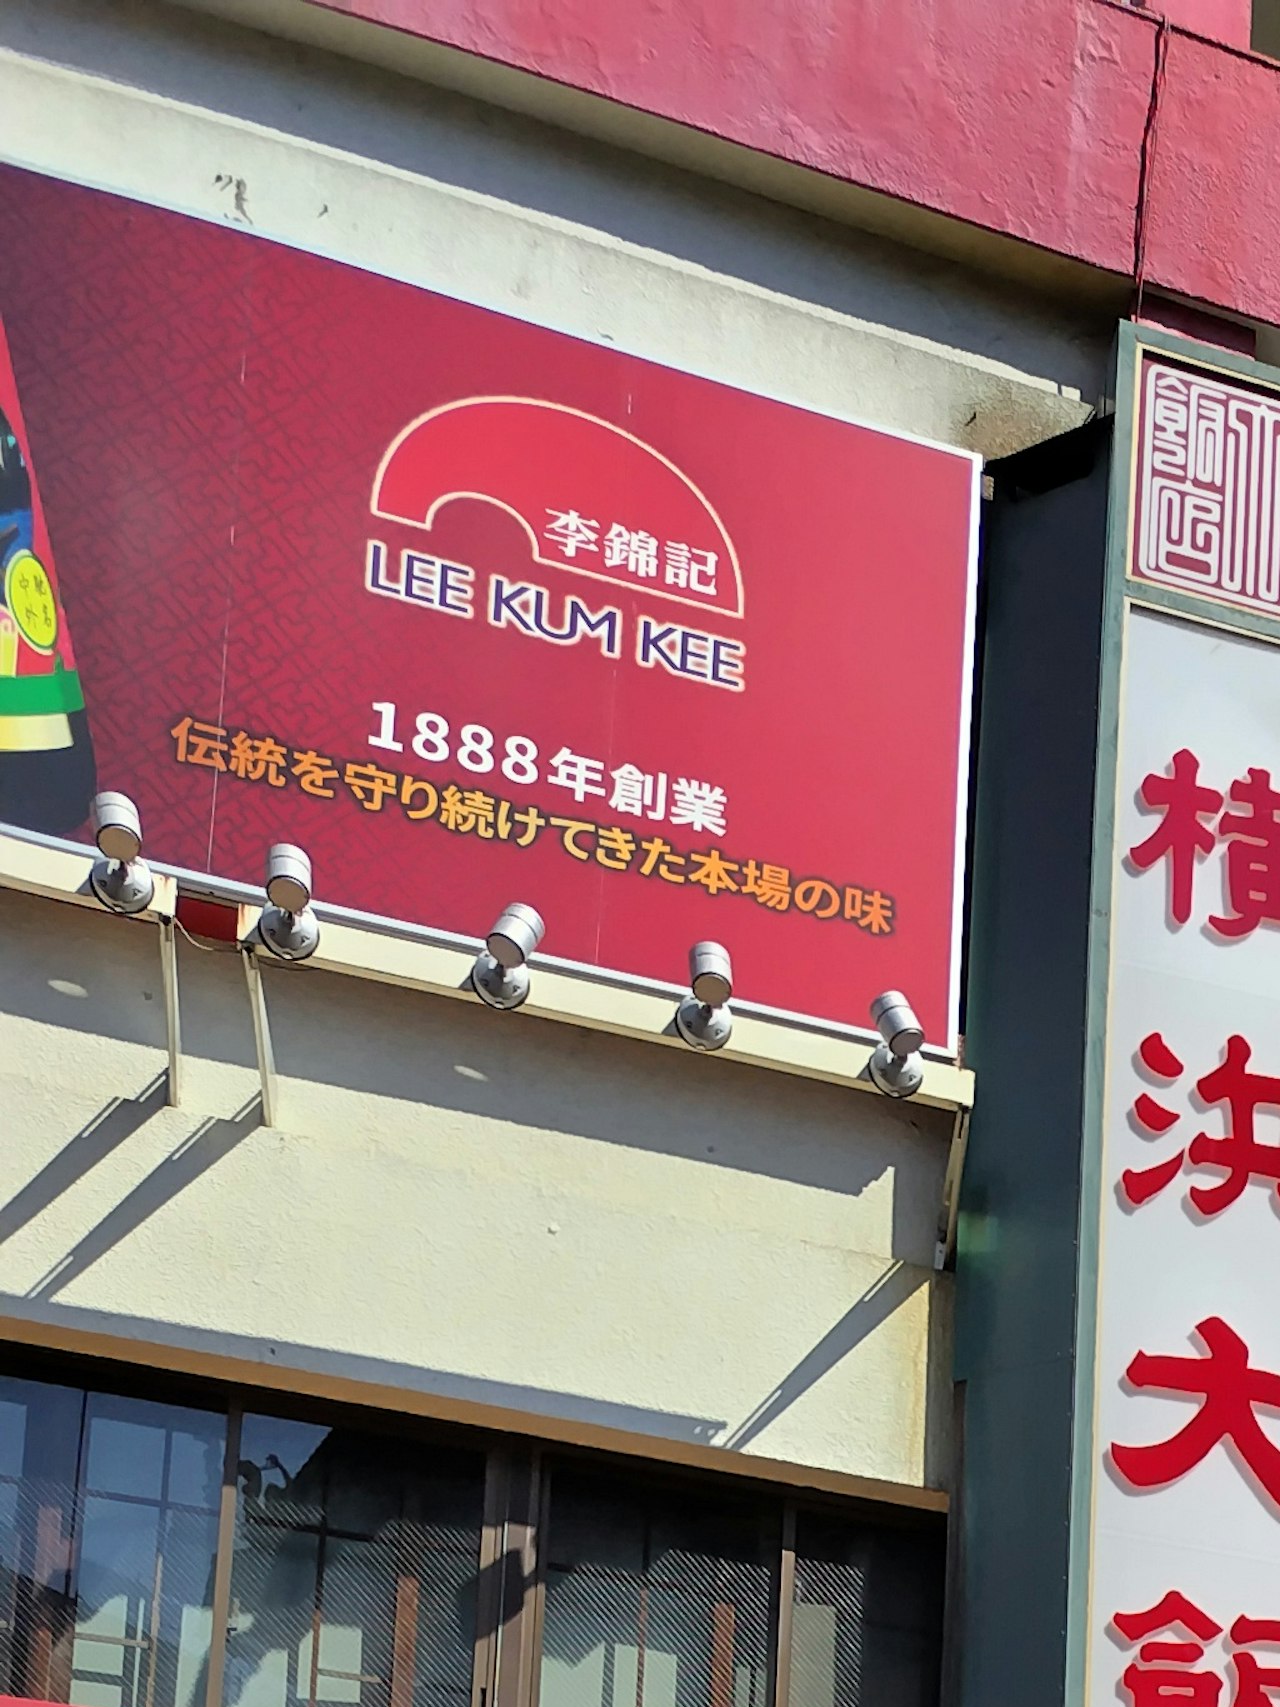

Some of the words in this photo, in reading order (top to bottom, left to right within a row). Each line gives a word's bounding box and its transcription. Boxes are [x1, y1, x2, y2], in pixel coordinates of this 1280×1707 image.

[366, 540, 474, 616] LEE
[491, 581, 623, 659] KUM
[638, 624, 747, 692] KEE
[543, 505, 718, 597] 李錦記
[169, 715, 896, 935] 伝統を守り続けてきた本場の味
[367, 700, 728, 838] 1888年創業
